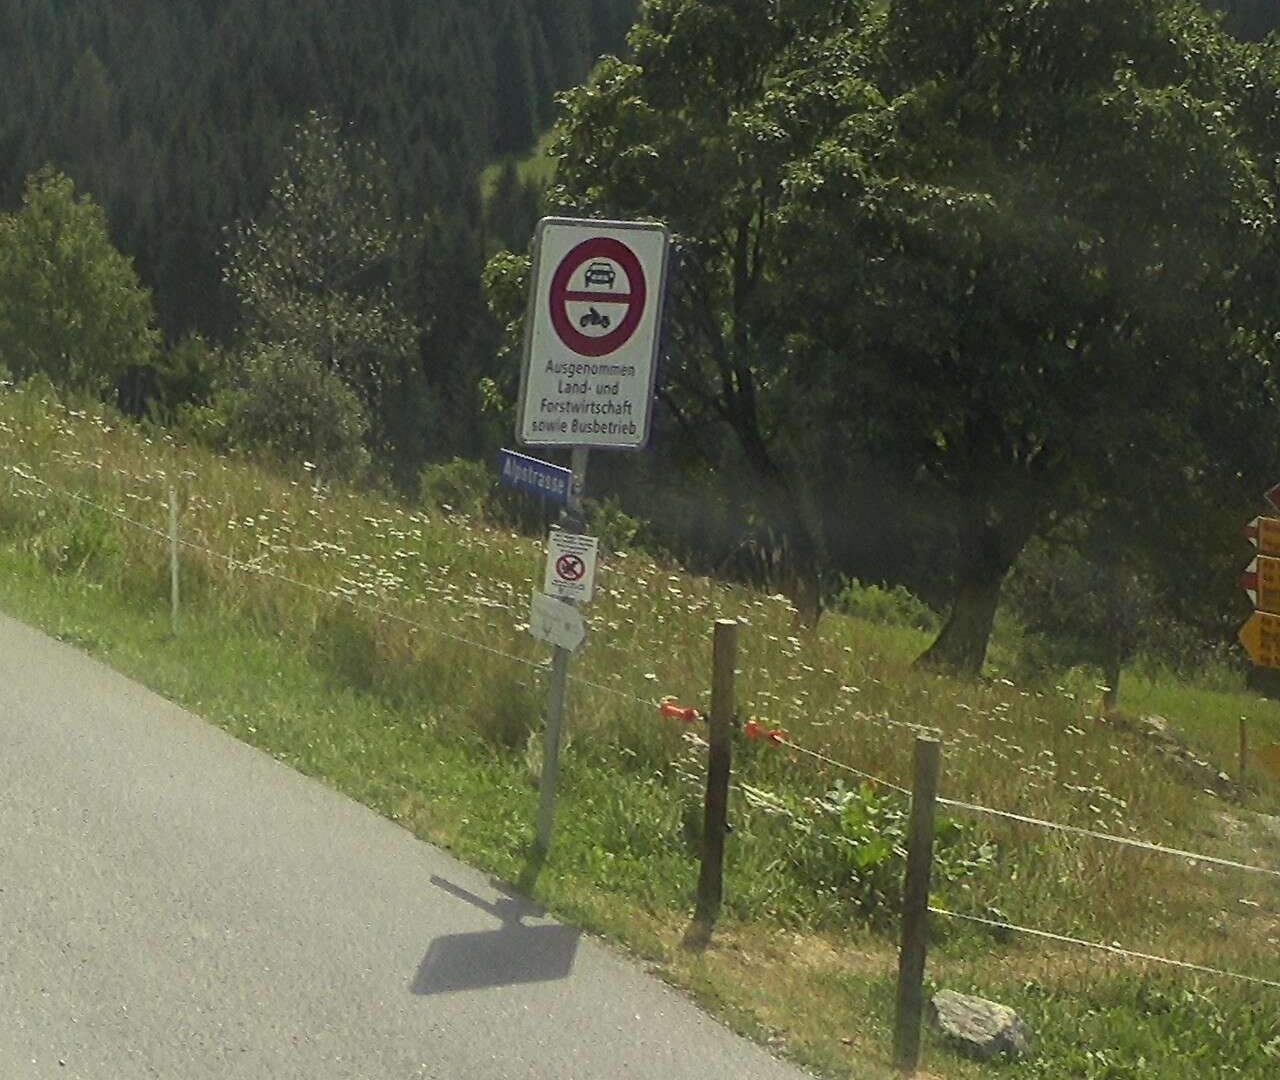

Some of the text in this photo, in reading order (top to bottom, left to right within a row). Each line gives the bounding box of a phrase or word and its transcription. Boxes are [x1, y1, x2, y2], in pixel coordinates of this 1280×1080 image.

[545, 359, 636, 378] Ausgenommen
[558, 379, 620, 395] Land- und
[541, 398, 633, 415] Forstwirtschaft
[531, 418, 637, 435] sowie Busbetrieb
[503, 456, 565, 495] Alpstrasse
